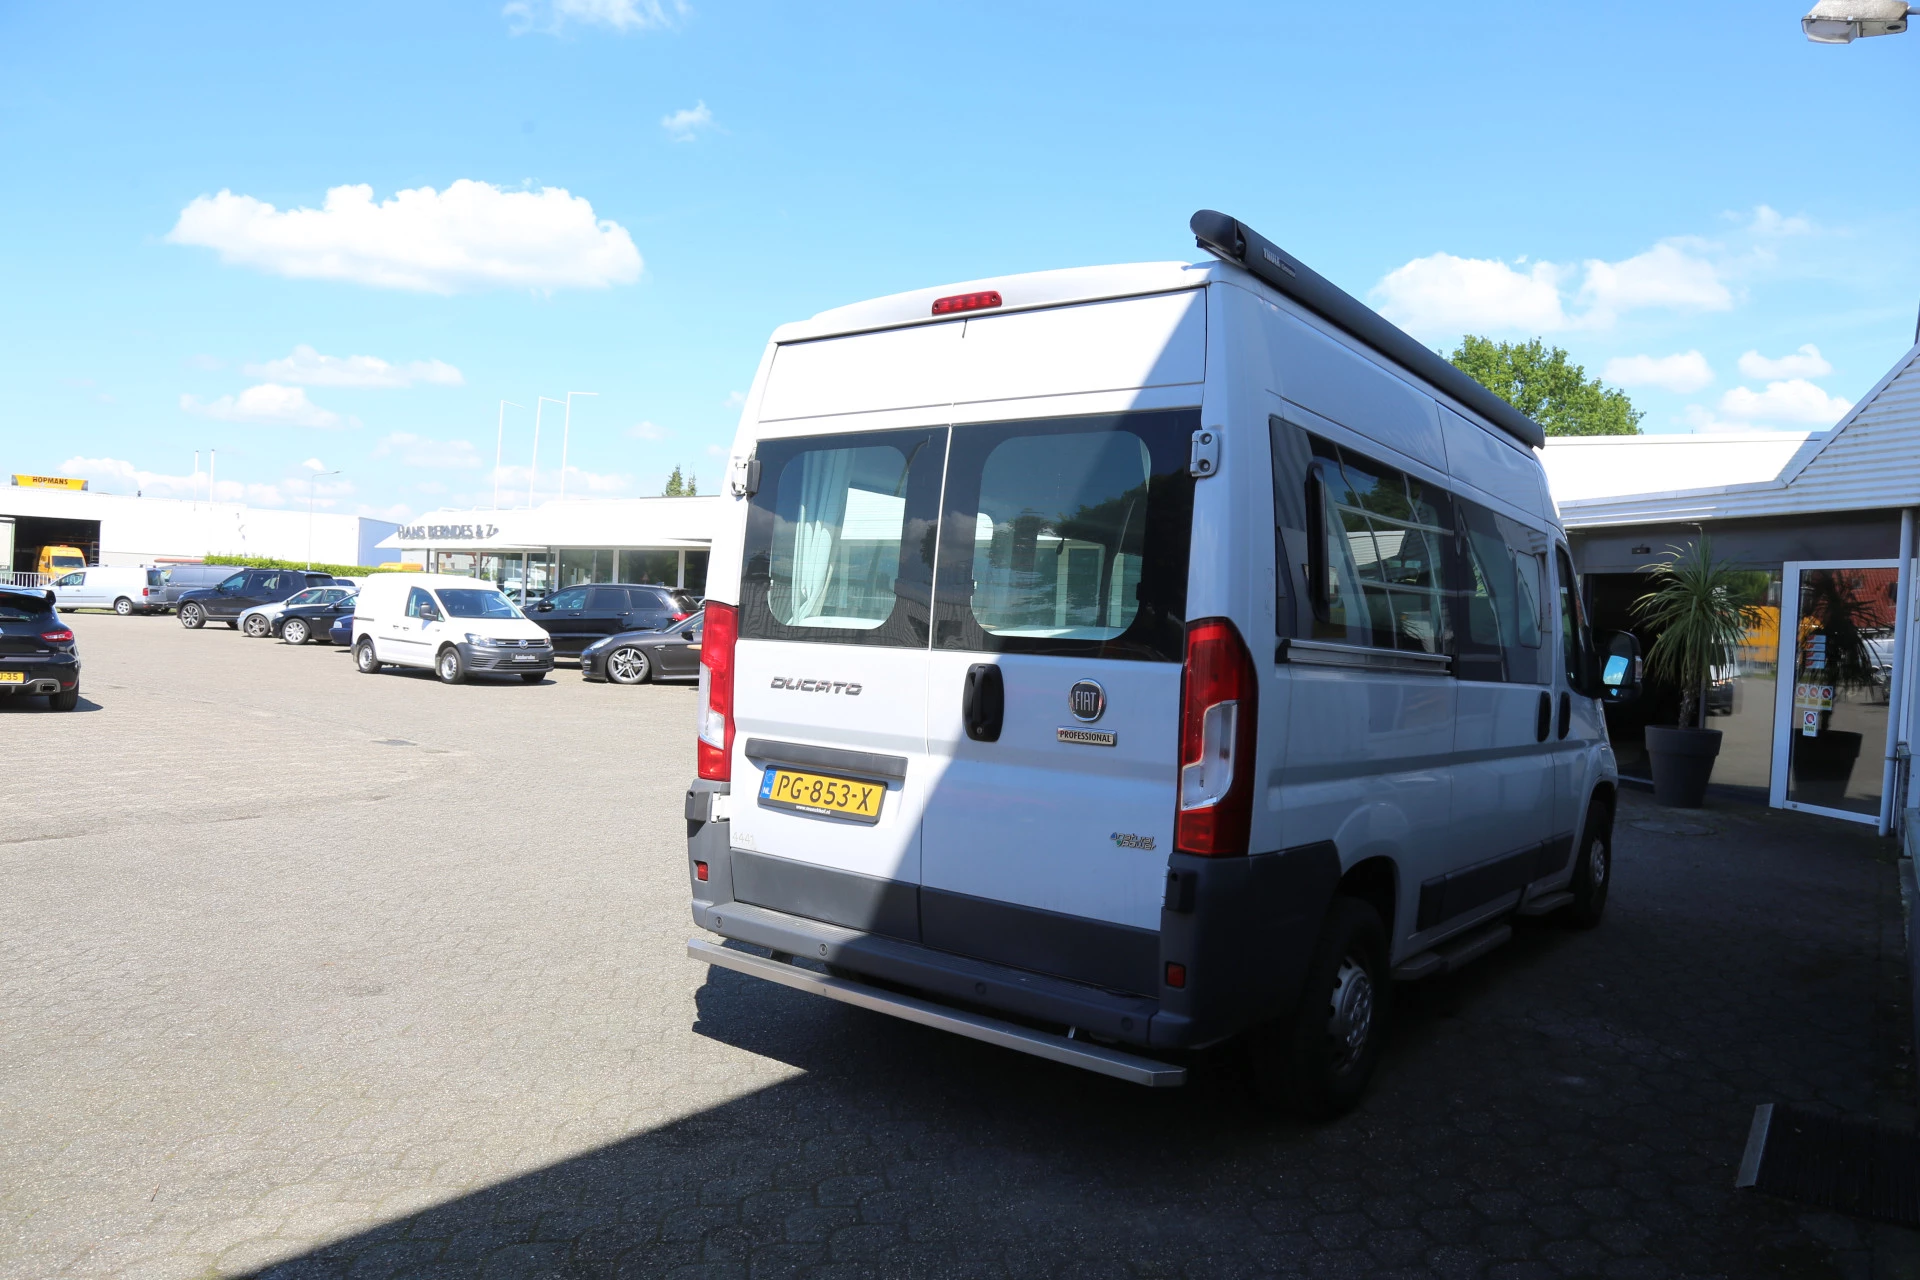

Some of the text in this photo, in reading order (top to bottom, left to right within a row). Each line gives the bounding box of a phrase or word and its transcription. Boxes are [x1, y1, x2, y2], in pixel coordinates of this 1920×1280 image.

[32, 476, 69, 485] HOPMANS
[398, 524, 425, 540] HANS
[427, 524, 474, 540] BERNDES
[475, 524, 484, 540] &
[770, 676, 863, 696] DUCATO
[1075, 690, 1097, 712] FIAT
[1059, 730, 1112, 743] PROFESSIONAL
[762, 786, 771, 795] NL
[776, 774, 873, 812] PG-853-X
